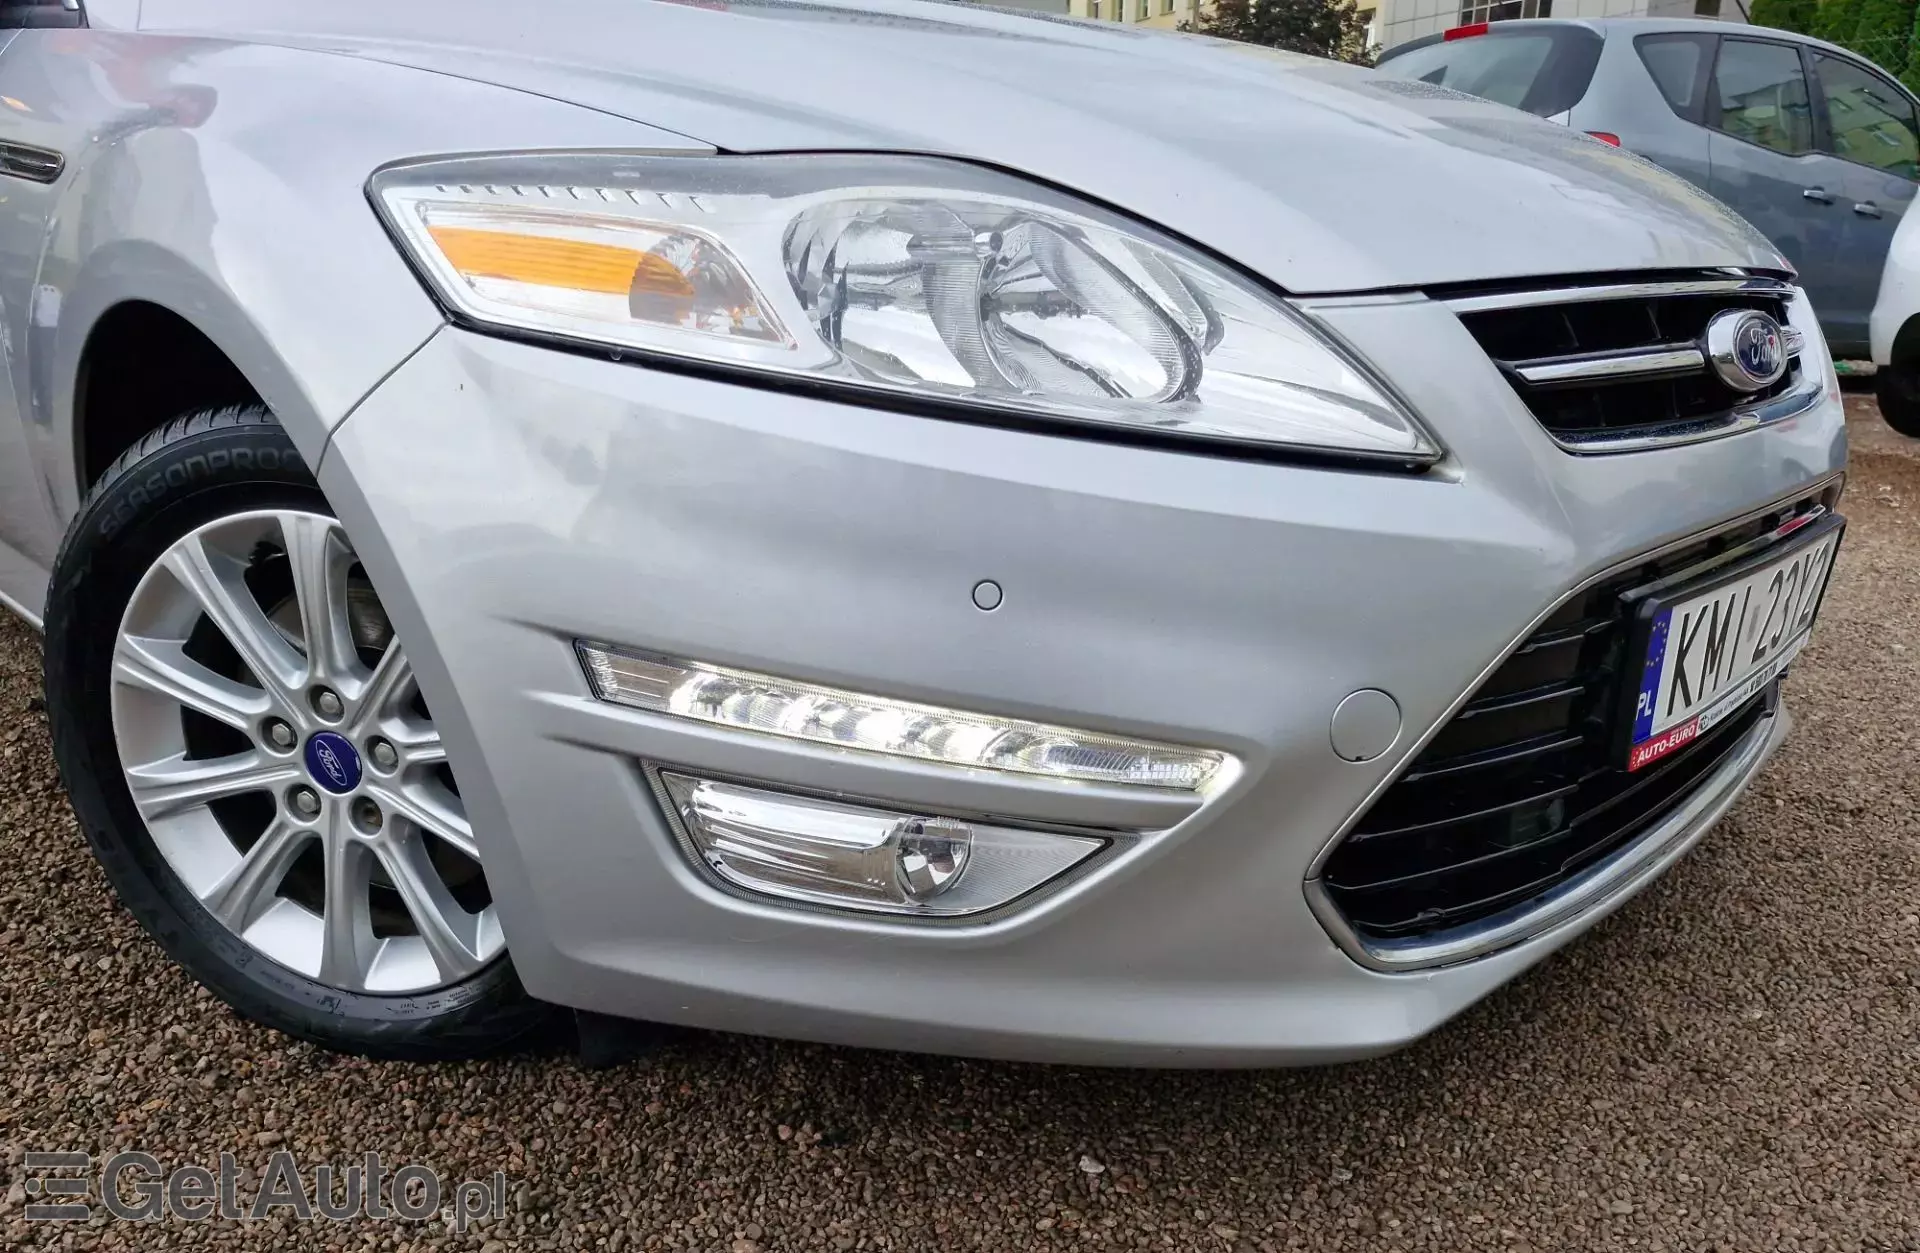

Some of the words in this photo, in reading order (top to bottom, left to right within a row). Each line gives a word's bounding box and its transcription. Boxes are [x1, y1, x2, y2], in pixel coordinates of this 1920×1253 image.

[1667, 585, 1751, 718] KMI
[1751, 541, 1831, 665] 23Y2
[1635, 690, 1652, 721] PL
[1637, 722, 1695, 764] AUTO-EURO
[318, 748, 343, 779] Ford
